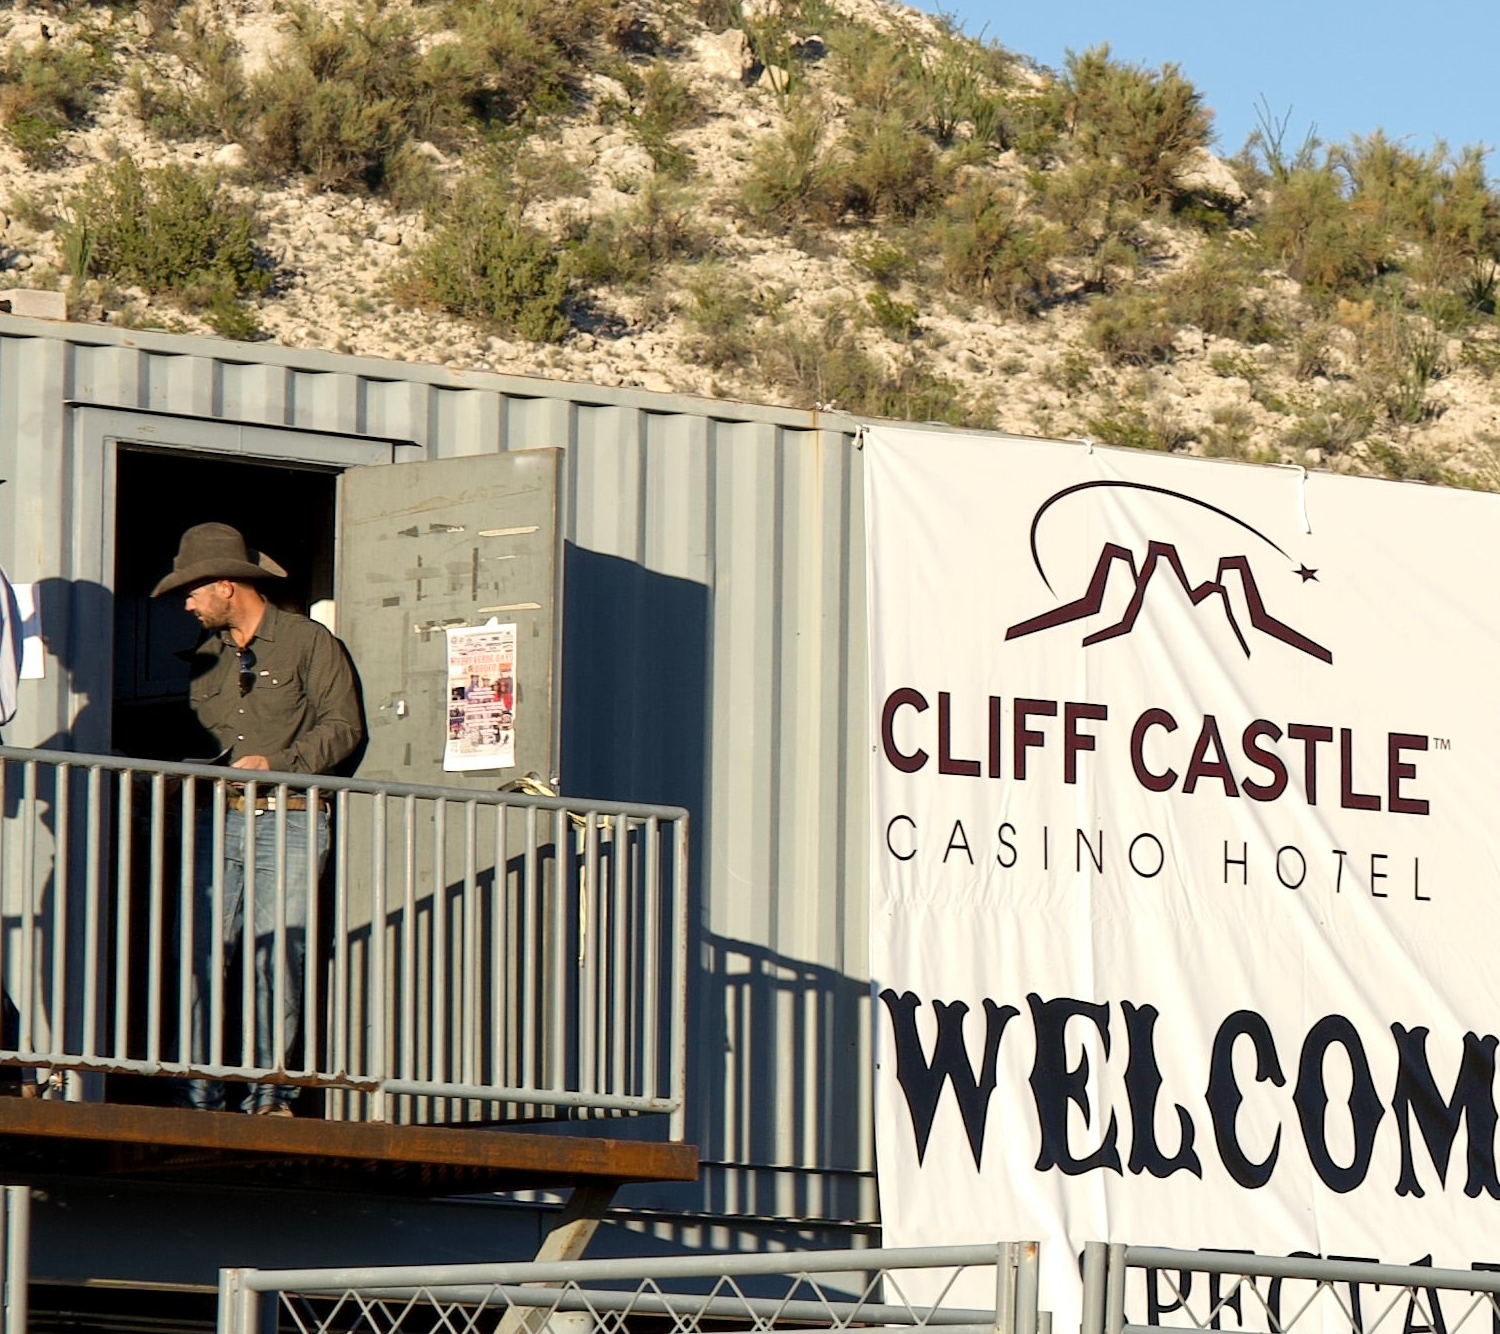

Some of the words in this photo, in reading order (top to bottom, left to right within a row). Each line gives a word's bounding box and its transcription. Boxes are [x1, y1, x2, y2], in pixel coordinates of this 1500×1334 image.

[881, 687, 1107, 785] CLIFF
[1130, 707, 1430, 816] CASTLE
[886, 814, 1164, 878] CASINO
[1224, 840, 1431, 901] HOTEL
